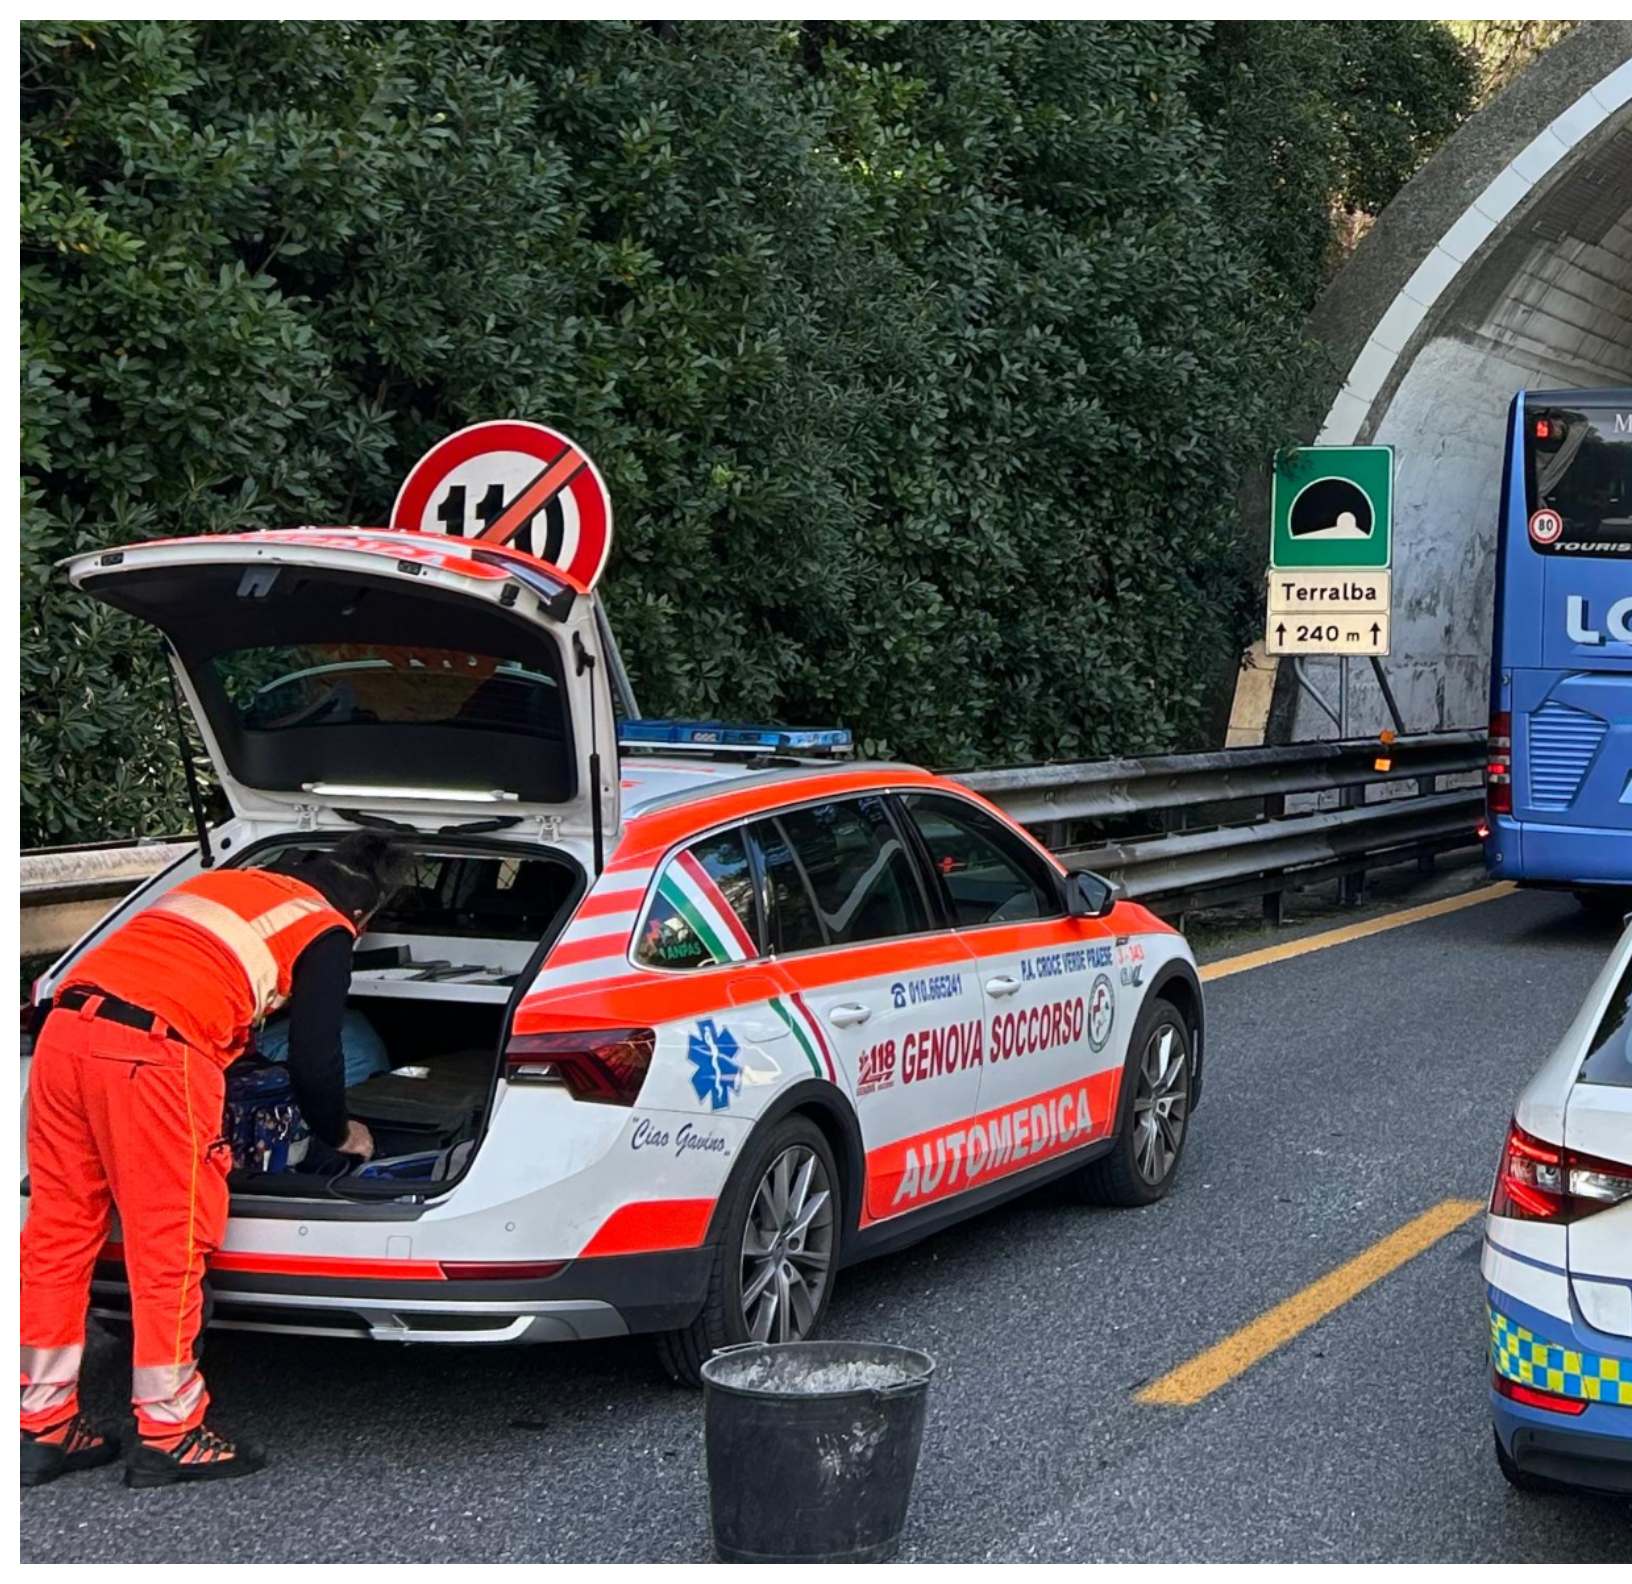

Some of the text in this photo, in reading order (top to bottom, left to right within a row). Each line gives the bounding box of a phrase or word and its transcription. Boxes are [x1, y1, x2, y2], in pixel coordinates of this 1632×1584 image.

[1282, 583, 1377, 601] Terralba
[1297, 625, 1360, 642] 240 m
[1037, 954, 1063, 978] CROCE
[1062, 950, 1086, 973] VERDE
[901, 1019, 984, 1085] GENOVA
[990, 996, 1084, 1064] SOCCORSO
[870, 1039, 896, 1074] 118
[891, 1087, 1093, 1206] AUTOMEDICA
